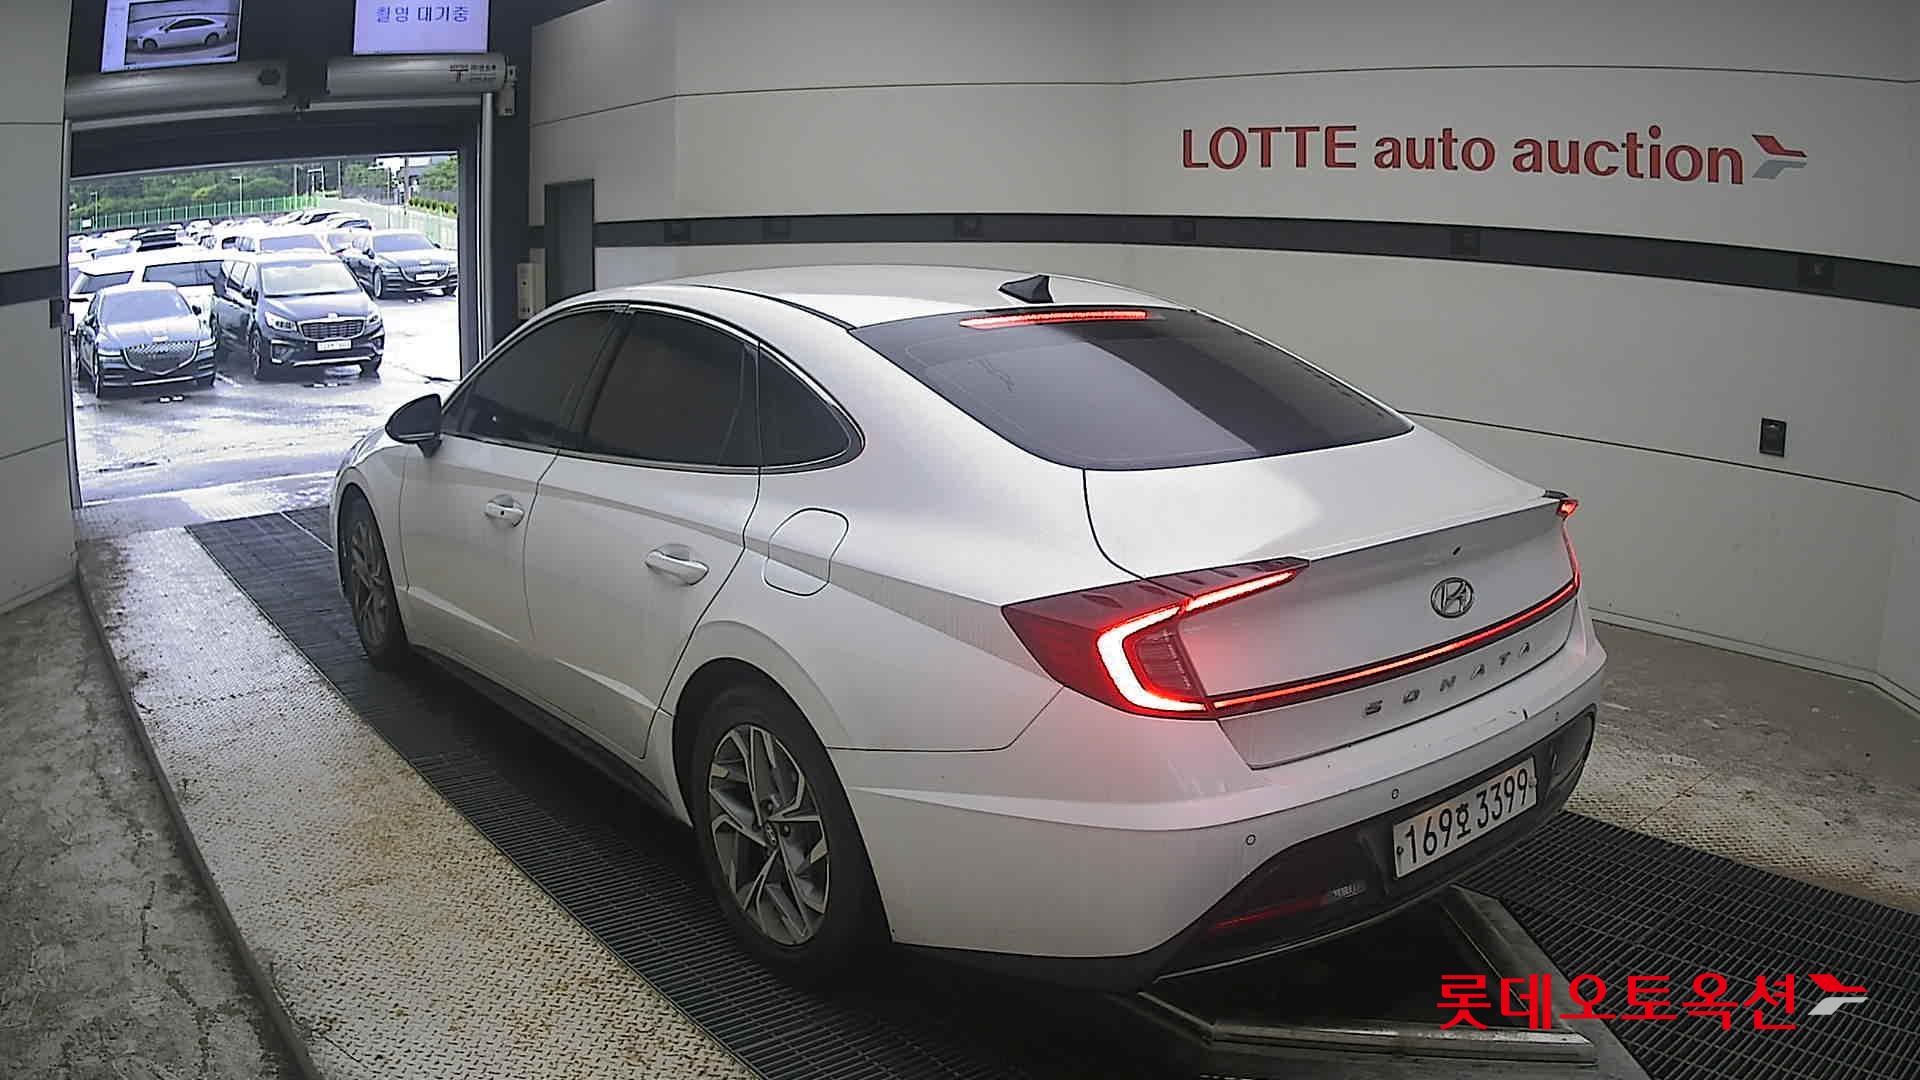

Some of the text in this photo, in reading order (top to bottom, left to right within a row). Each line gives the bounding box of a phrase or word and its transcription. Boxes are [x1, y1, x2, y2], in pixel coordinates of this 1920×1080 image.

[417, 5, 470, 23] 대기중
[1183, 125, 1744, 185] LOTTE auto auction
[1363, 641, 1532, 718] SONATA
